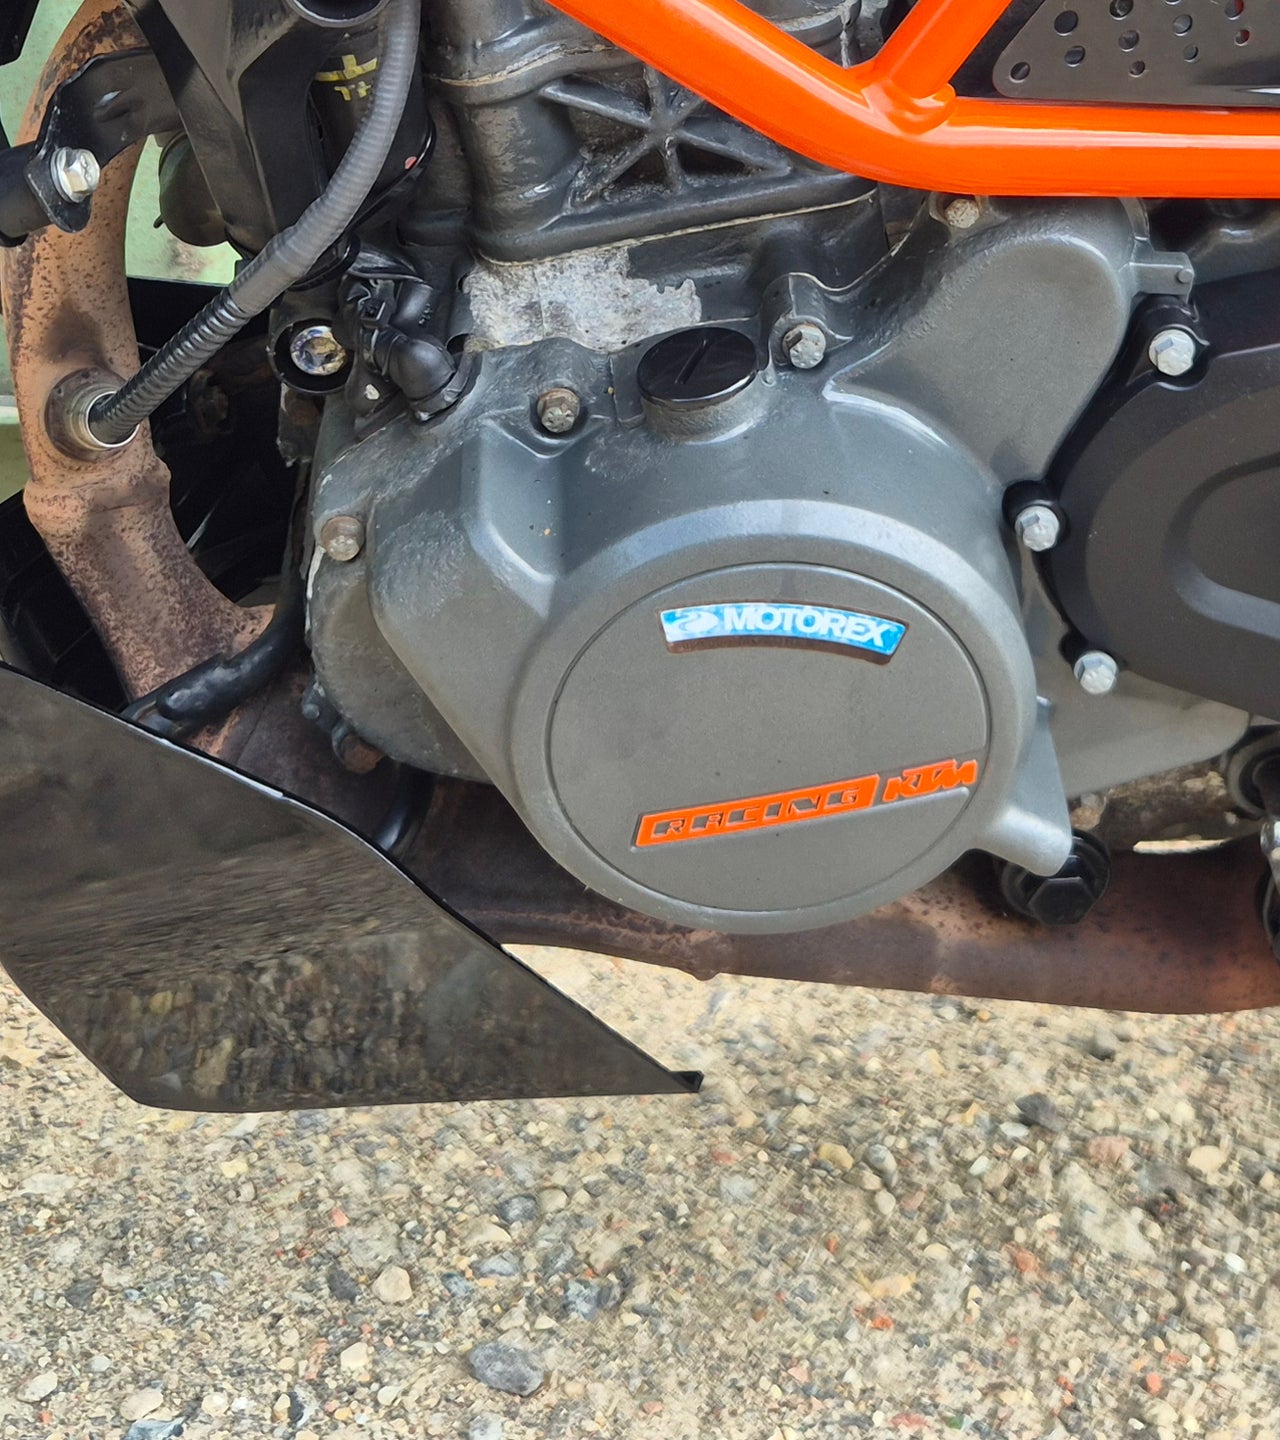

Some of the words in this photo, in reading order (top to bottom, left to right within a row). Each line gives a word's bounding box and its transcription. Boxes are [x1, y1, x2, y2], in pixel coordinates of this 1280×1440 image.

[723, 606, 891, 647] MOTOREX
[649, 786, 861, 839] RACING
[882, 758, 978, 803] KTM
